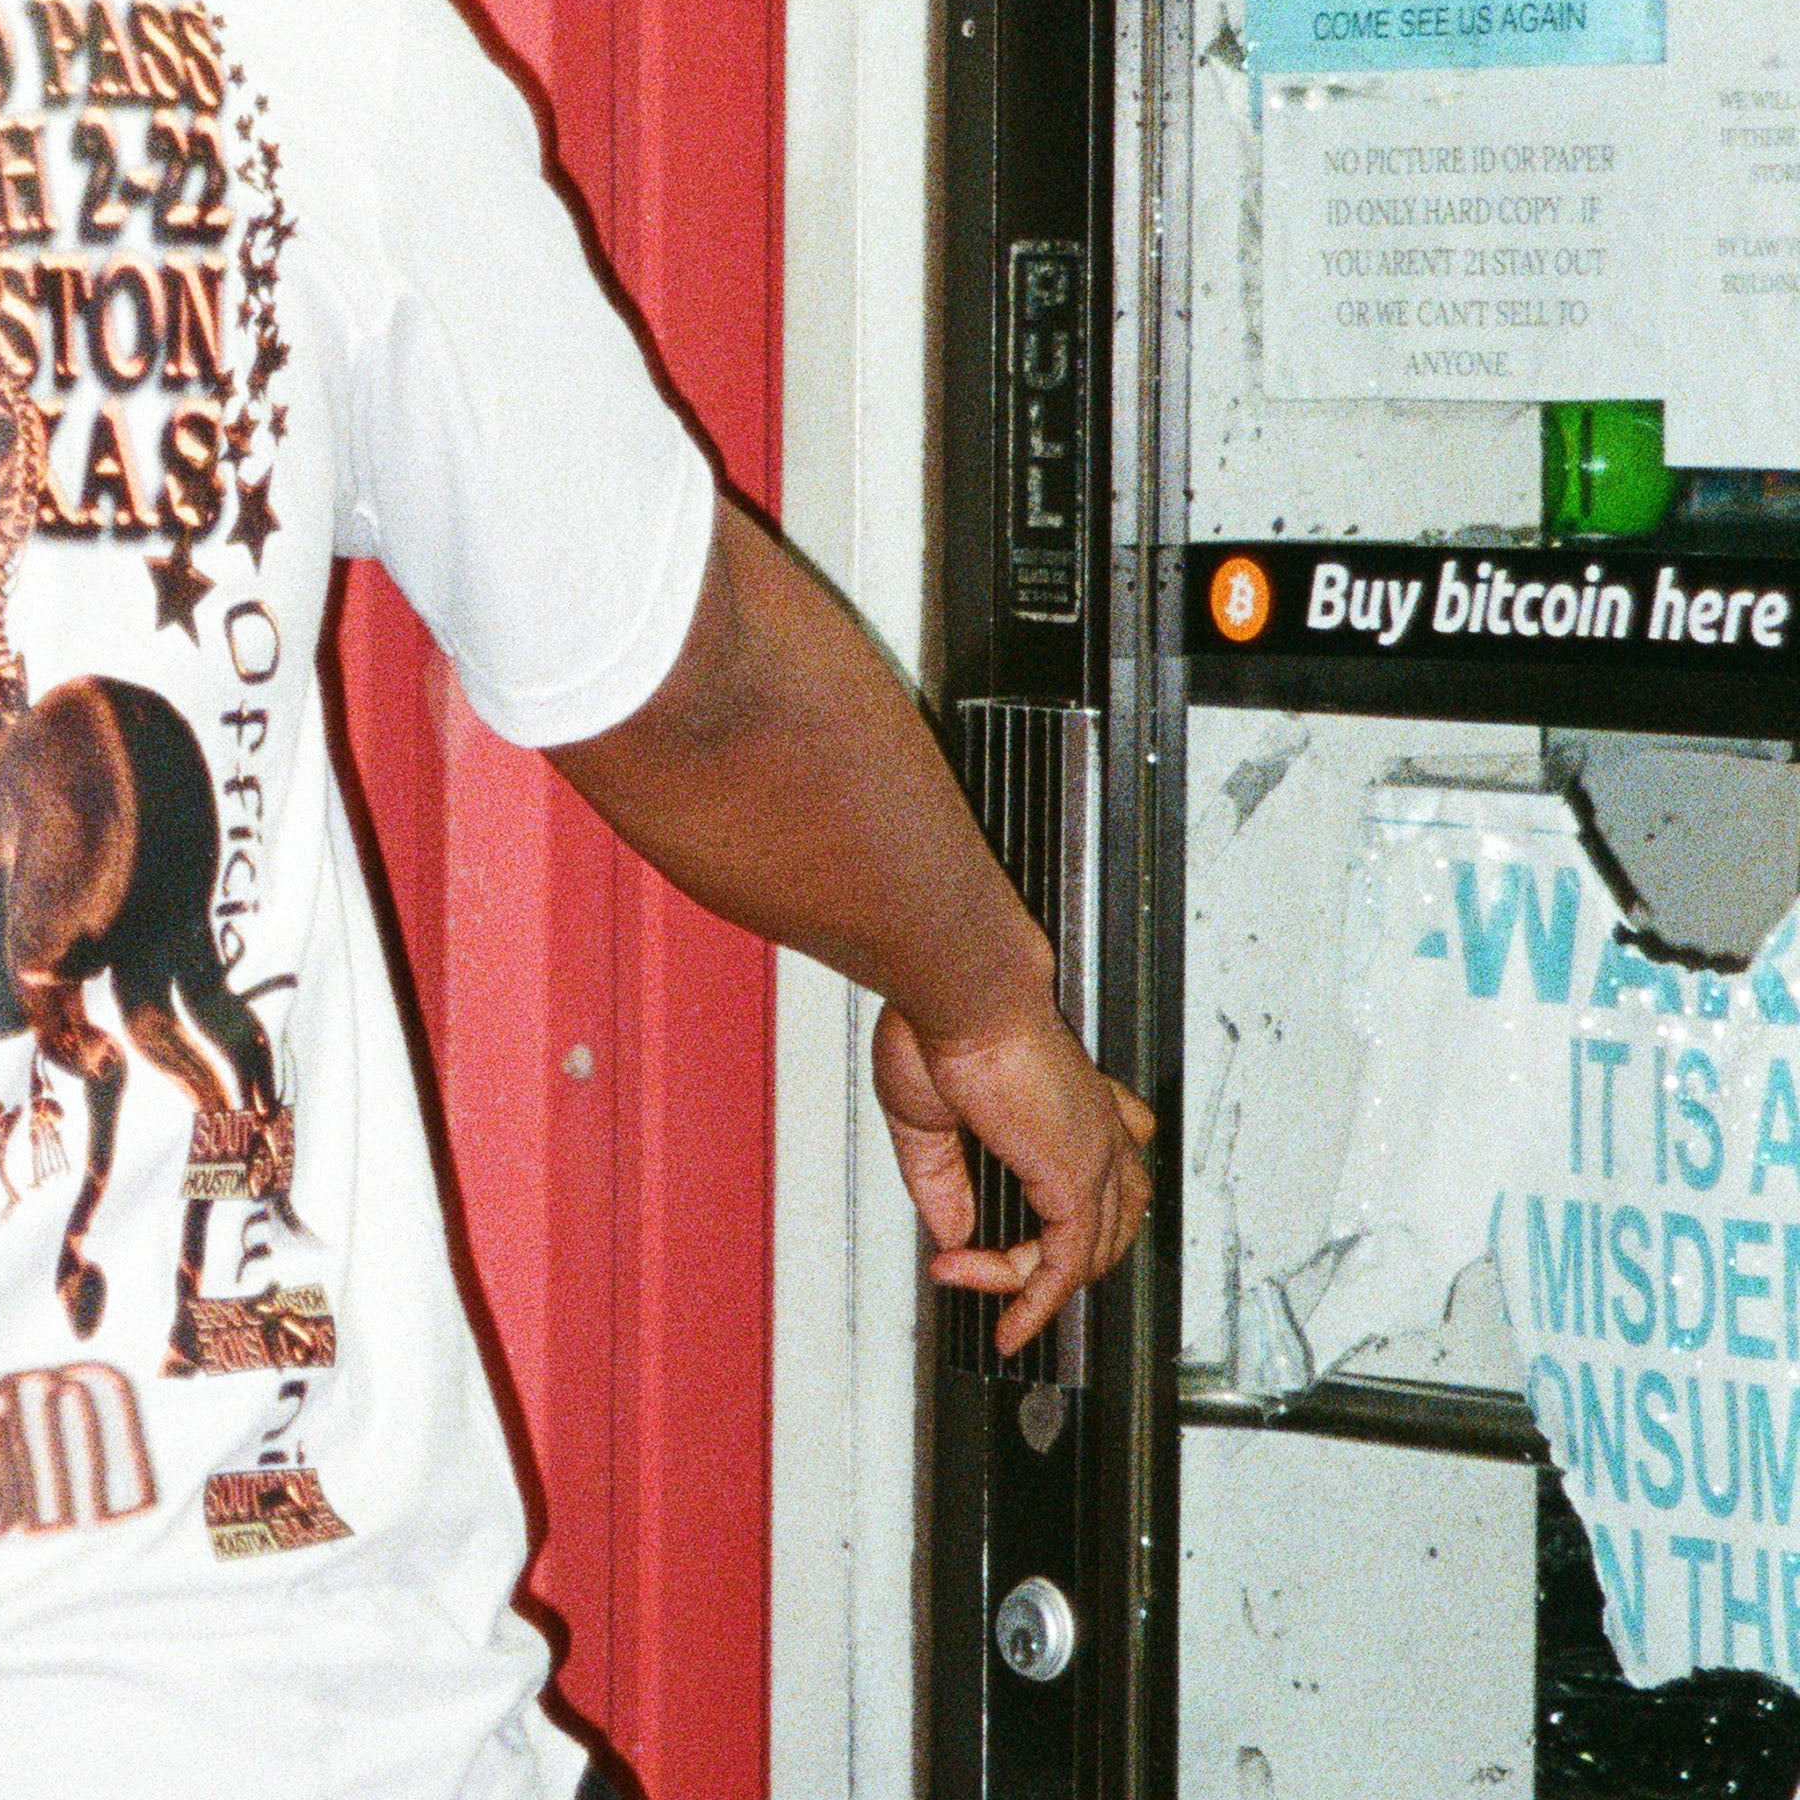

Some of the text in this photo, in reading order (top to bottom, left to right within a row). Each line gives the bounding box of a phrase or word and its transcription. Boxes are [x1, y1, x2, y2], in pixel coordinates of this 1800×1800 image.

[1313, 0, 1587, 43] COME SEE US AGAIN
[72, 107, 232, 246] 2-22
[1324, 144, 1617, 175] NO PICTURE ID OR PAPER
[1326, 198, 1351, 226] ID
[1356, 197, 1416, 226] ONLY
[1424, 197, 1493, 226] HARD
[1321, 248, 1369, 278] YOU
[1464, 248, 1486, 276] 21
[1492, 248, 1546, 277] STAY
[1553, 247, 1607, 277] OUT
[1335, 299, 1371, 328] OR
[1375, 299, 1409, 328] WE
[1496, 298, 1549, 328] SELL
[1553, 298, 1589, 328] TO
[1022, 259, 1070, 530] PULL
[1306, 559, 1791, 649] Buy bitcoin here
[1569, 1036, 1800, 1196] IT IS A
